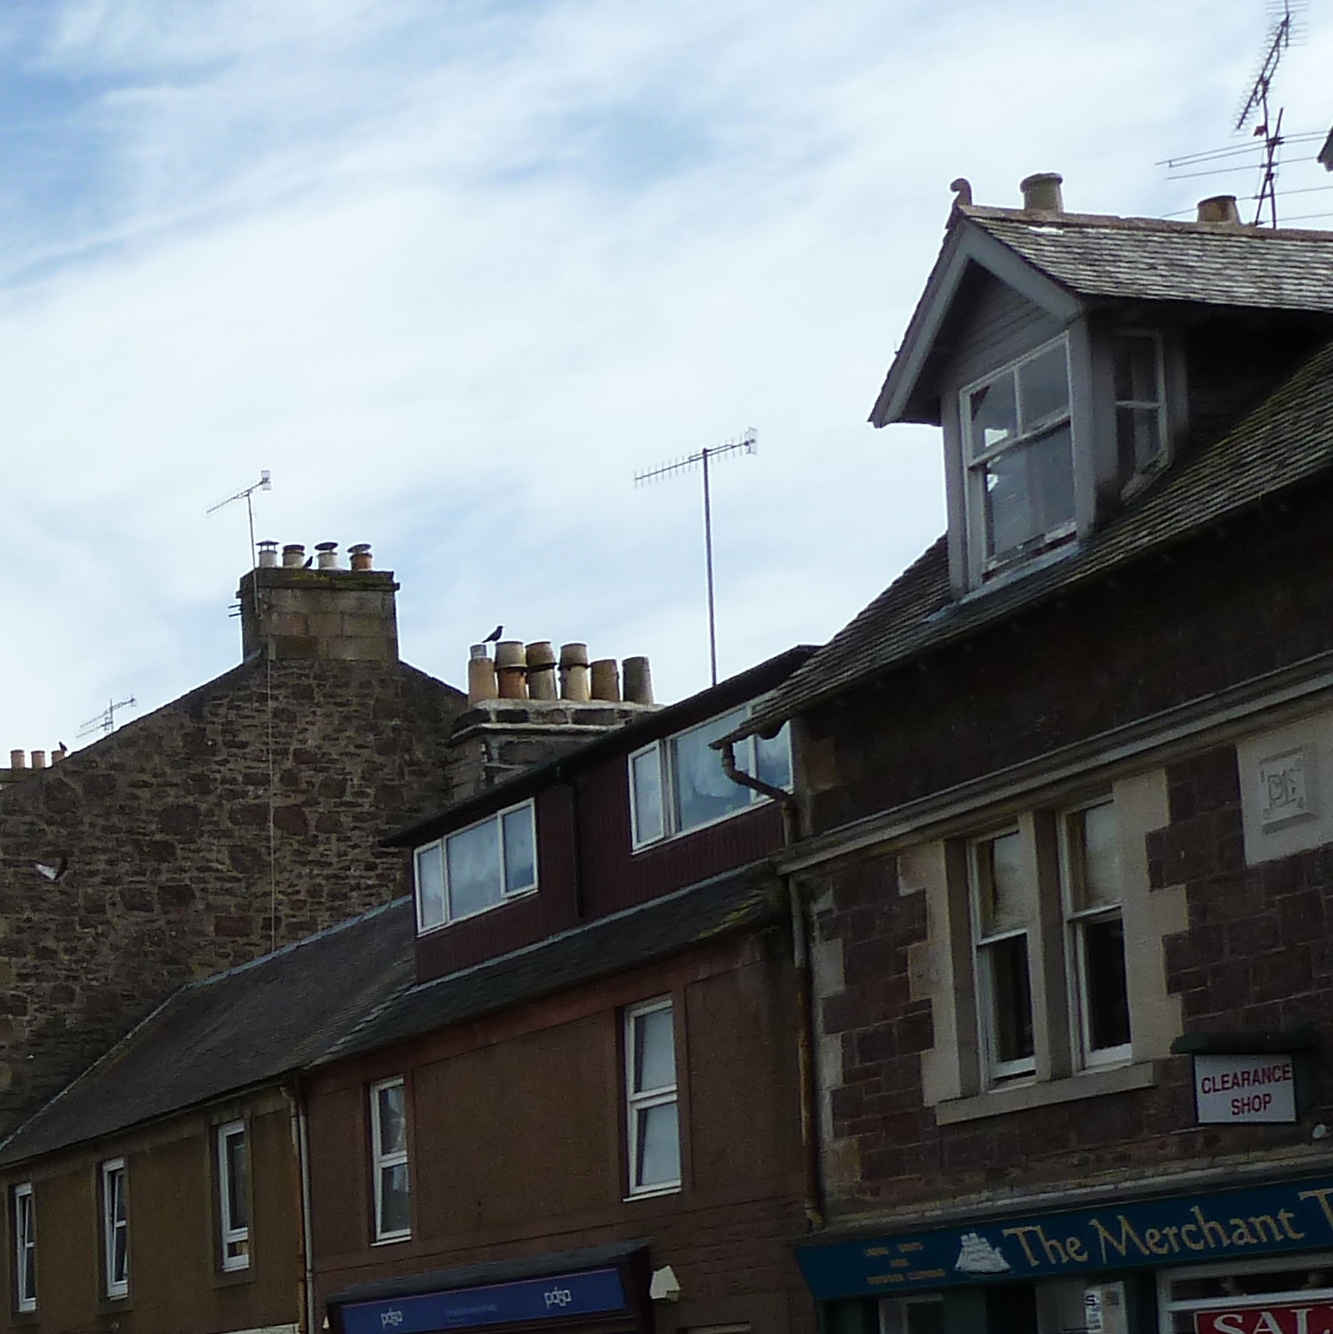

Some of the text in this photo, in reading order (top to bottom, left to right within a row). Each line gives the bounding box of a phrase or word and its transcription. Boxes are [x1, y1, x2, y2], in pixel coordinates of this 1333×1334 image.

[1201, 1063, 1293, 1095] CLEARANCE
[1231, 1093, 1272, 1117] SHOP
[1002, 1225, 1088, 1267] The
[1089, 1205, 1305, 1263] Merchant
